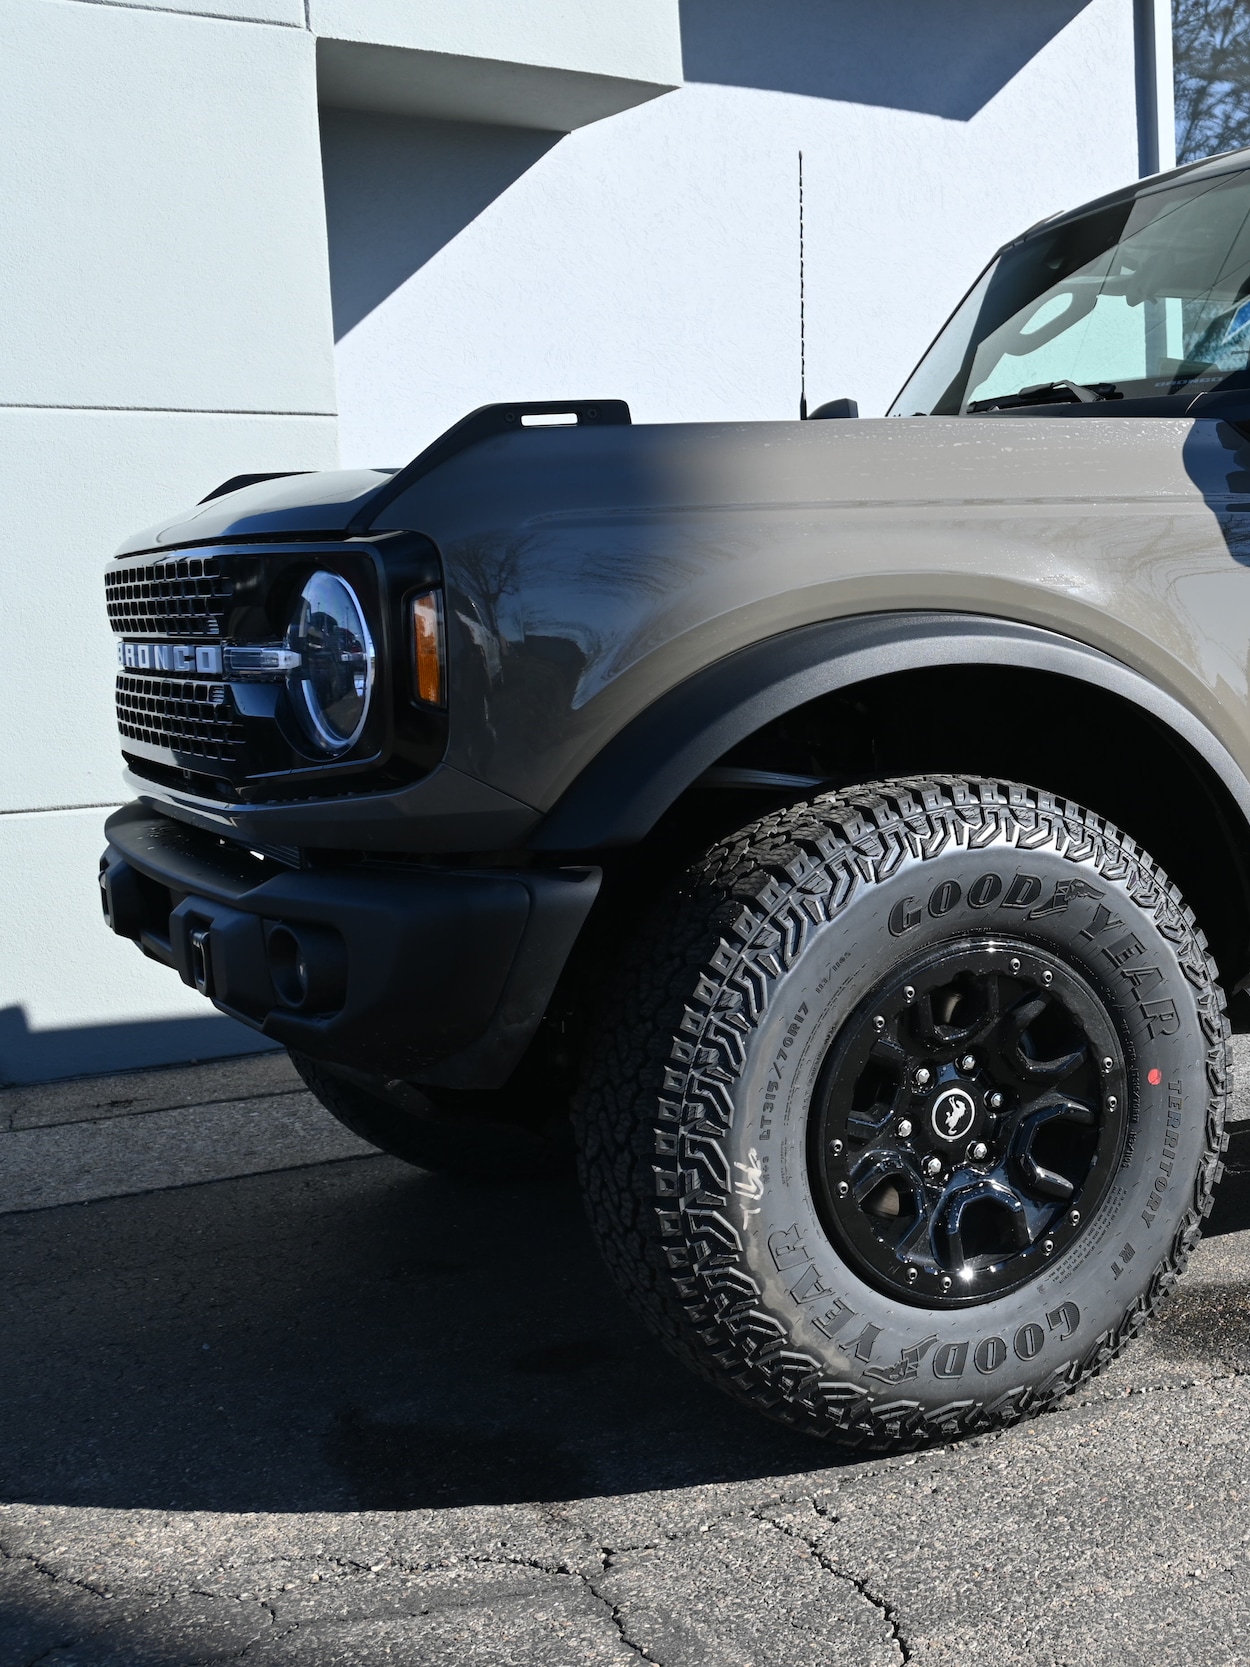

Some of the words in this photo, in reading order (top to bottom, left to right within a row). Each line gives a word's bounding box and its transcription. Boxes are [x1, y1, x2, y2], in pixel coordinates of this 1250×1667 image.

[117, 642, 219, 674] BRONCO
[888, 872, 1181, 1040] GOODYEAR
[758, 1000, 810, 1141] LT315/70R17
[1141, 1079, 1182, 1229] TERRITORY
[767, 1221, 1081, 1382] GOODYEAR
